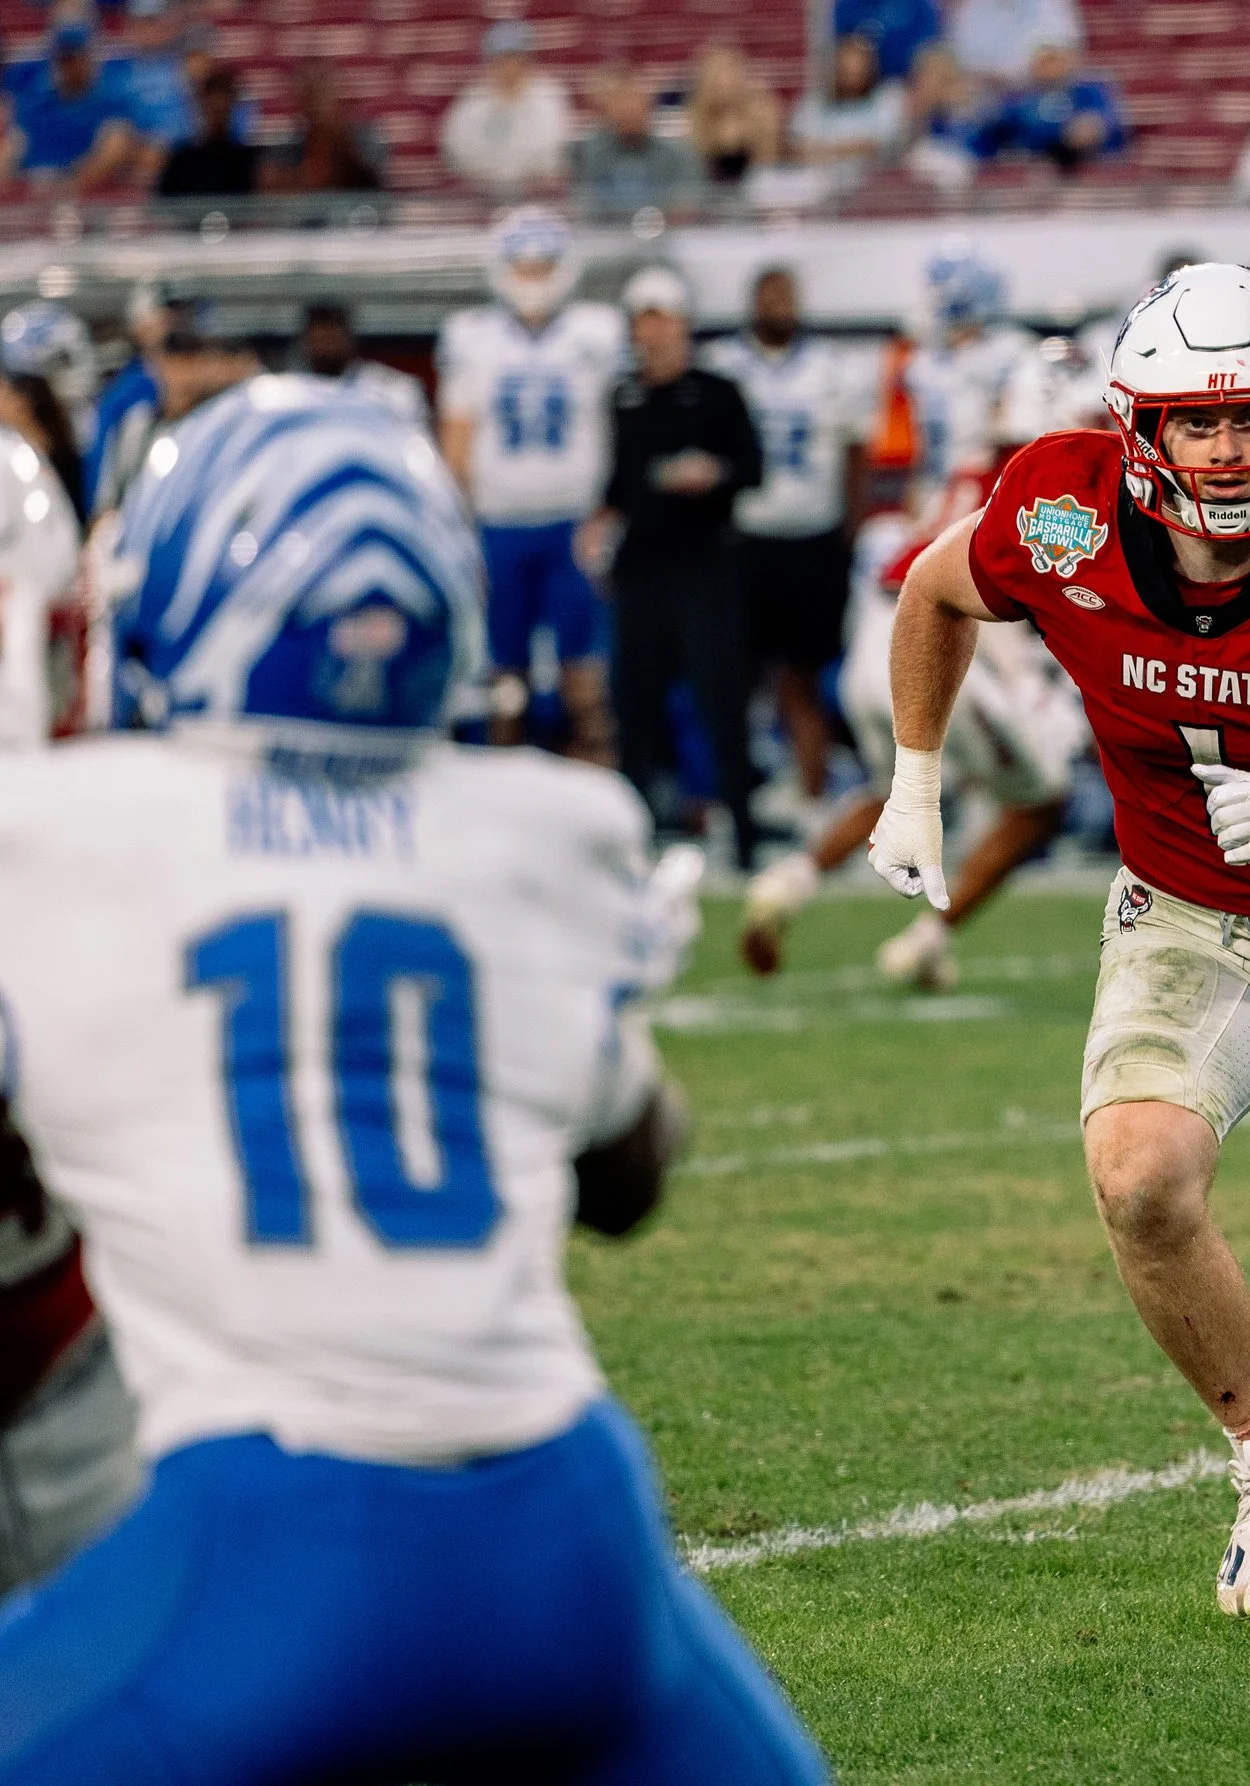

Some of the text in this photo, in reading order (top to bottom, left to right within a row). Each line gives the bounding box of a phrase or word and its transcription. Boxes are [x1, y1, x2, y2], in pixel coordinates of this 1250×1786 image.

[1208, 373, 1237, 389] HTT
[1039, 513, 1089, 528] MORTGAGE
[1208, 510, 1247, 520] Riddell
[1027, 517, 1094, 551] GASPARILLA
[1041, 533, 1075, 550] BOWL
[1069, 591, 1098, 605] ACC
[1122, 653, 1166, 694] NC
[183, 908, 506, 1249] 10
